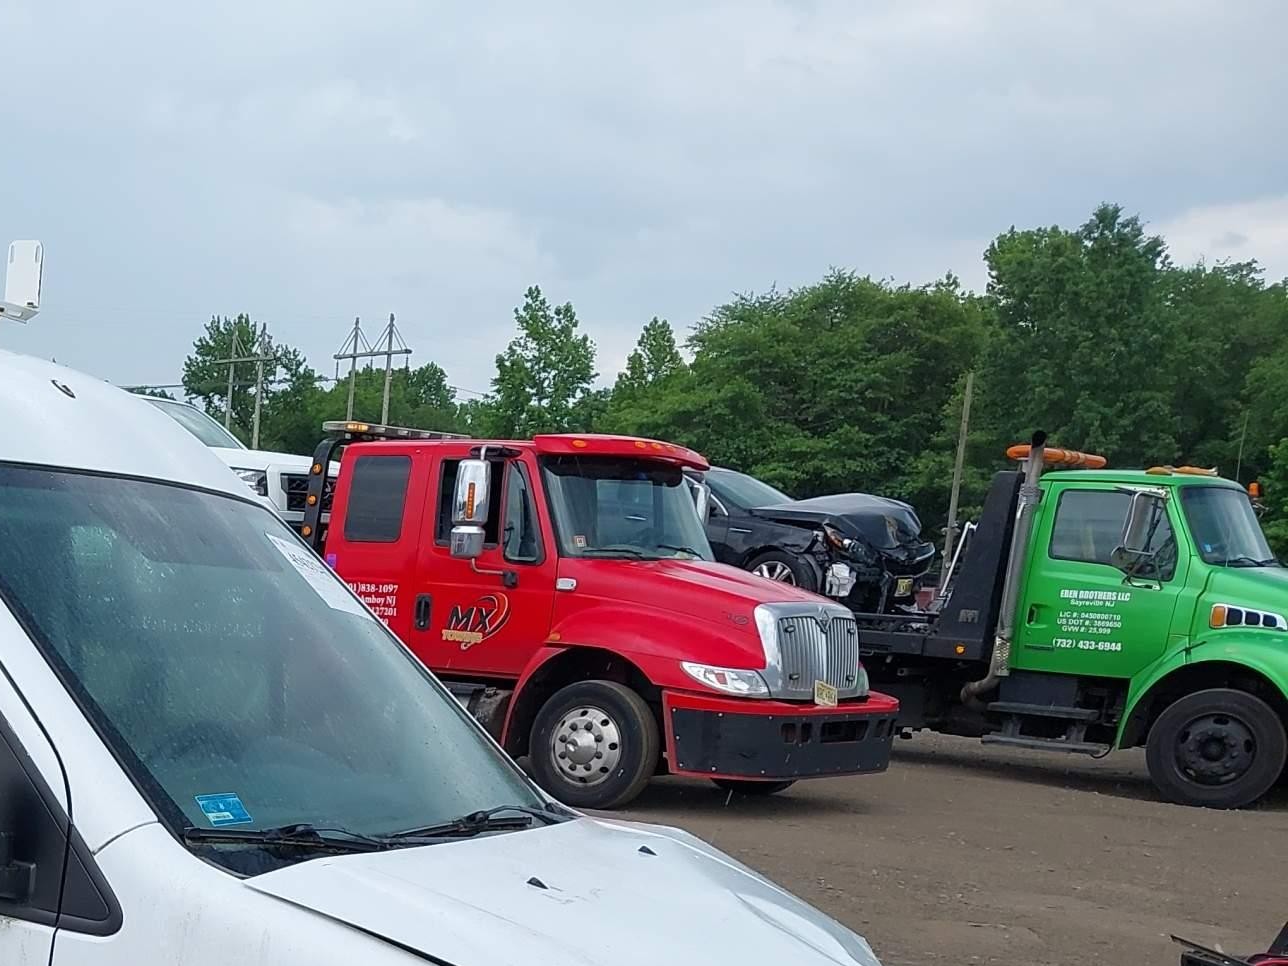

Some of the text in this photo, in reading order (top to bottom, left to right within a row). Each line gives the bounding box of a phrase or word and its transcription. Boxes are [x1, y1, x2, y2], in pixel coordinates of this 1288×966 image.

[348, 582, 398, 594] 01)838-1097
[386, 595, 397, 607] NJ
[1078, 590, 1117, 600] BROTHERS
[1117, 592, 1131, 601] LLC
[447, 605, 497, 633] MX
[1052, 637, 1122, 651] (732) 433-6944
